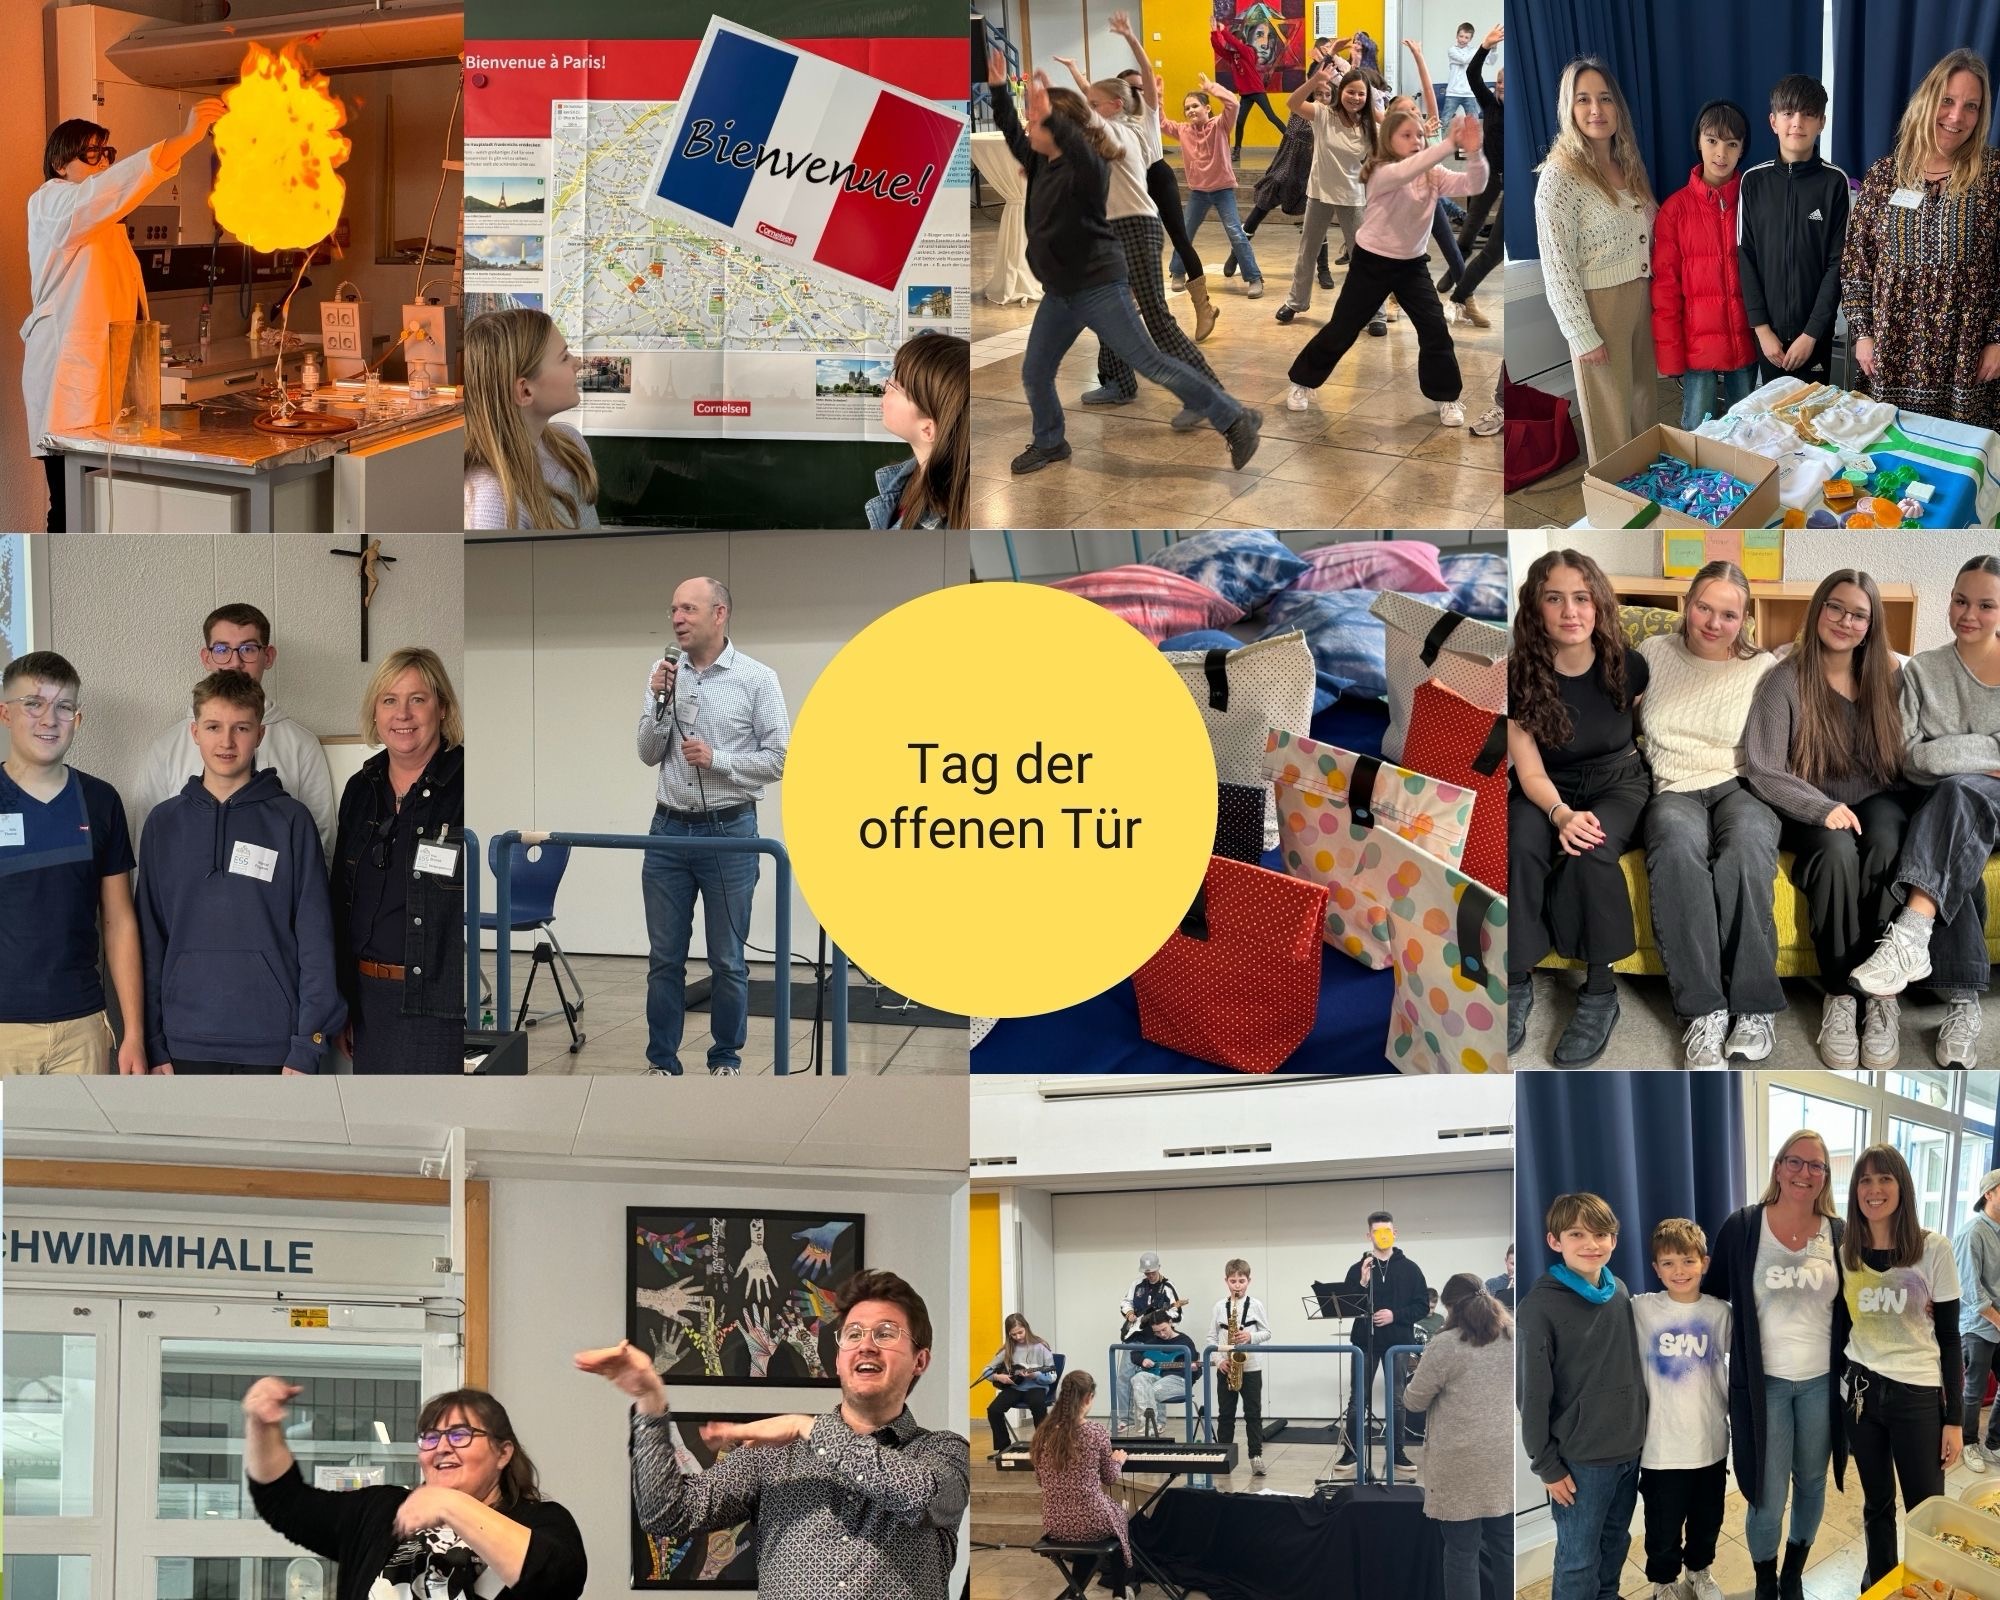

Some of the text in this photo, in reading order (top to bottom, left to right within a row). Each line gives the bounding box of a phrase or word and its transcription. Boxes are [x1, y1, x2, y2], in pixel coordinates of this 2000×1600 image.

[466, 53, 606, 69] Bienvenue à Paris!
[683, 118, 934, 207] Bienvenue!
[758, 223, 795, 244] Cornelsen
[696, 403, 748, 414] Cornelsen
[234, 856, 249, 866] ESS
[3, 1229, 313, 1274] HWIMMHALLE
[1765, 1265, 1826, 1291] SMN
[1858, 1287, 1908, 1314] SMN
[1659, 1332, 1709, 1358] SMN
